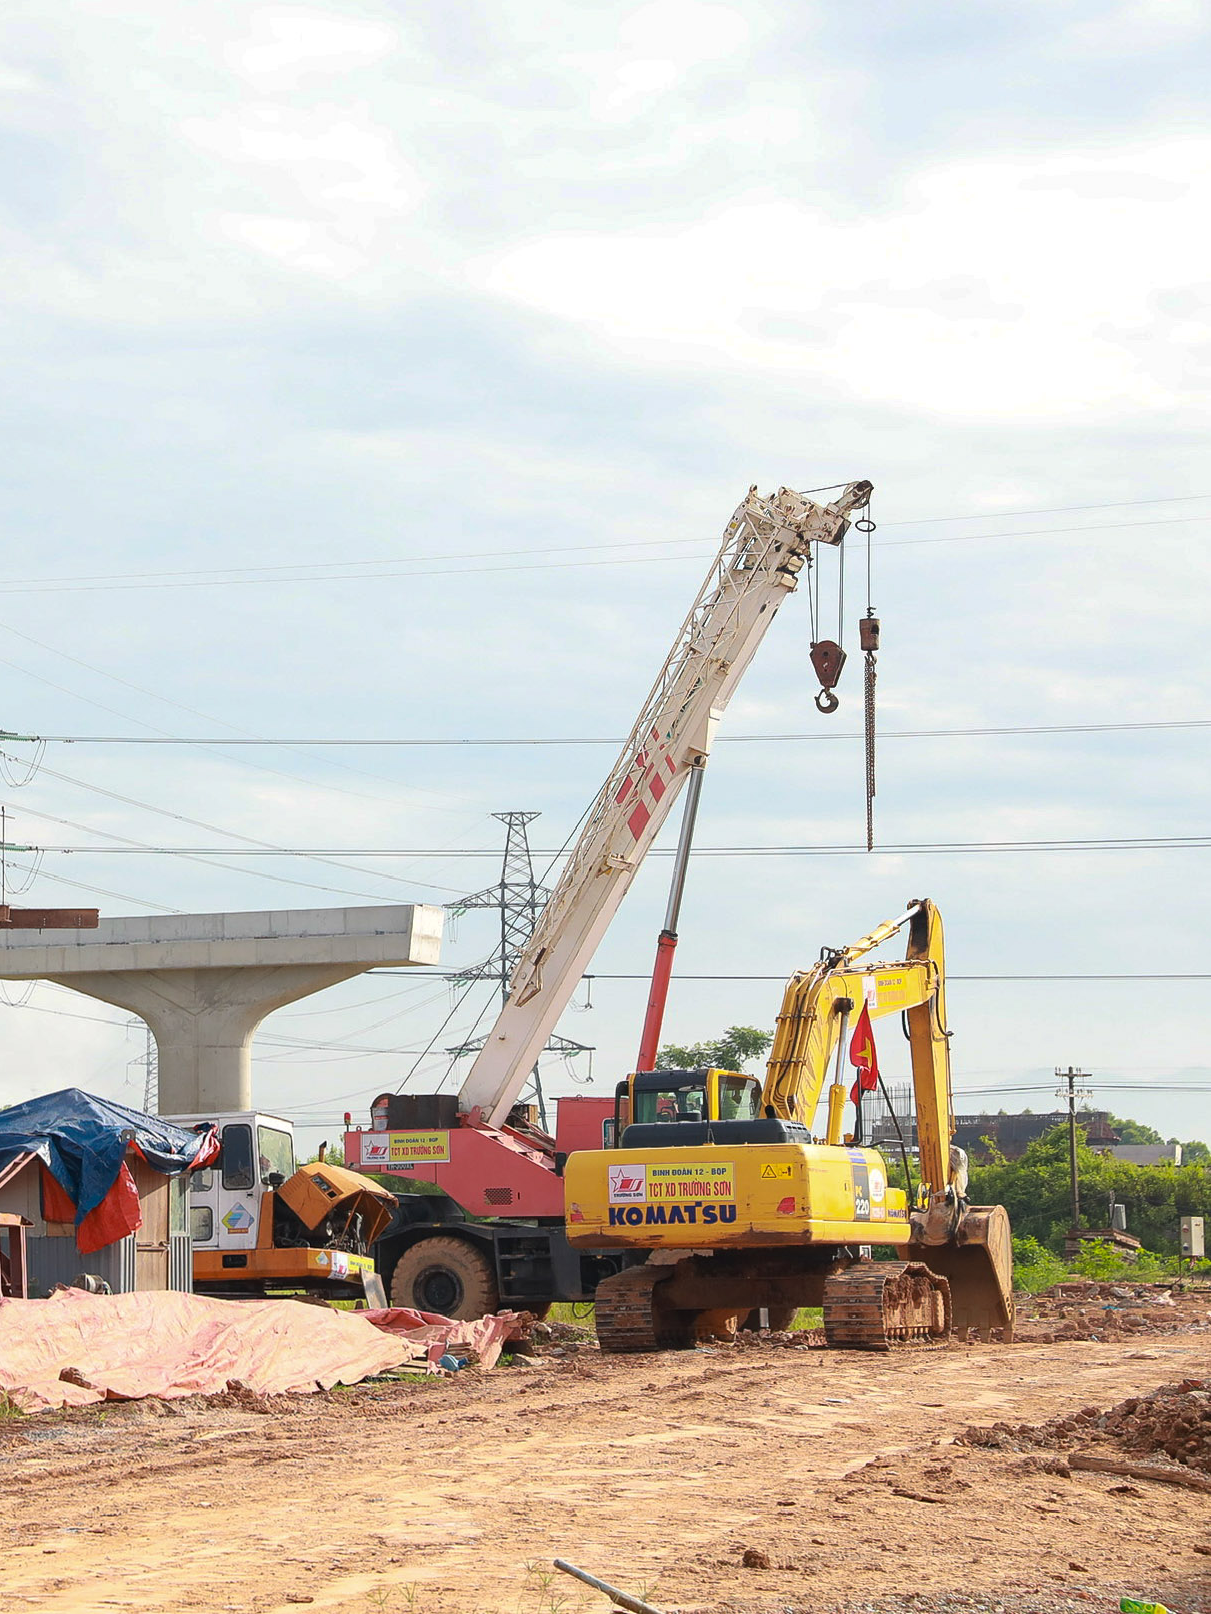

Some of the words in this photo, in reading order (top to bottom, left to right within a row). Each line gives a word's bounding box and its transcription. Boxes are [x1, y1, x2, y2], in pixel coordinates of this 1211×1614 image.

[402, 1146, 409, 1155] XD
[649, 1183, 663, 1197] TCT
[665, 1182, 676, 1197] XD
[678, 1178, 711, 1197] TRƯỜNG
[714, 1180, 731, 1196] SƠN
[608, 1201, 736, 1226] KOMATSU
[856, 1199, 870, 1214] 220
